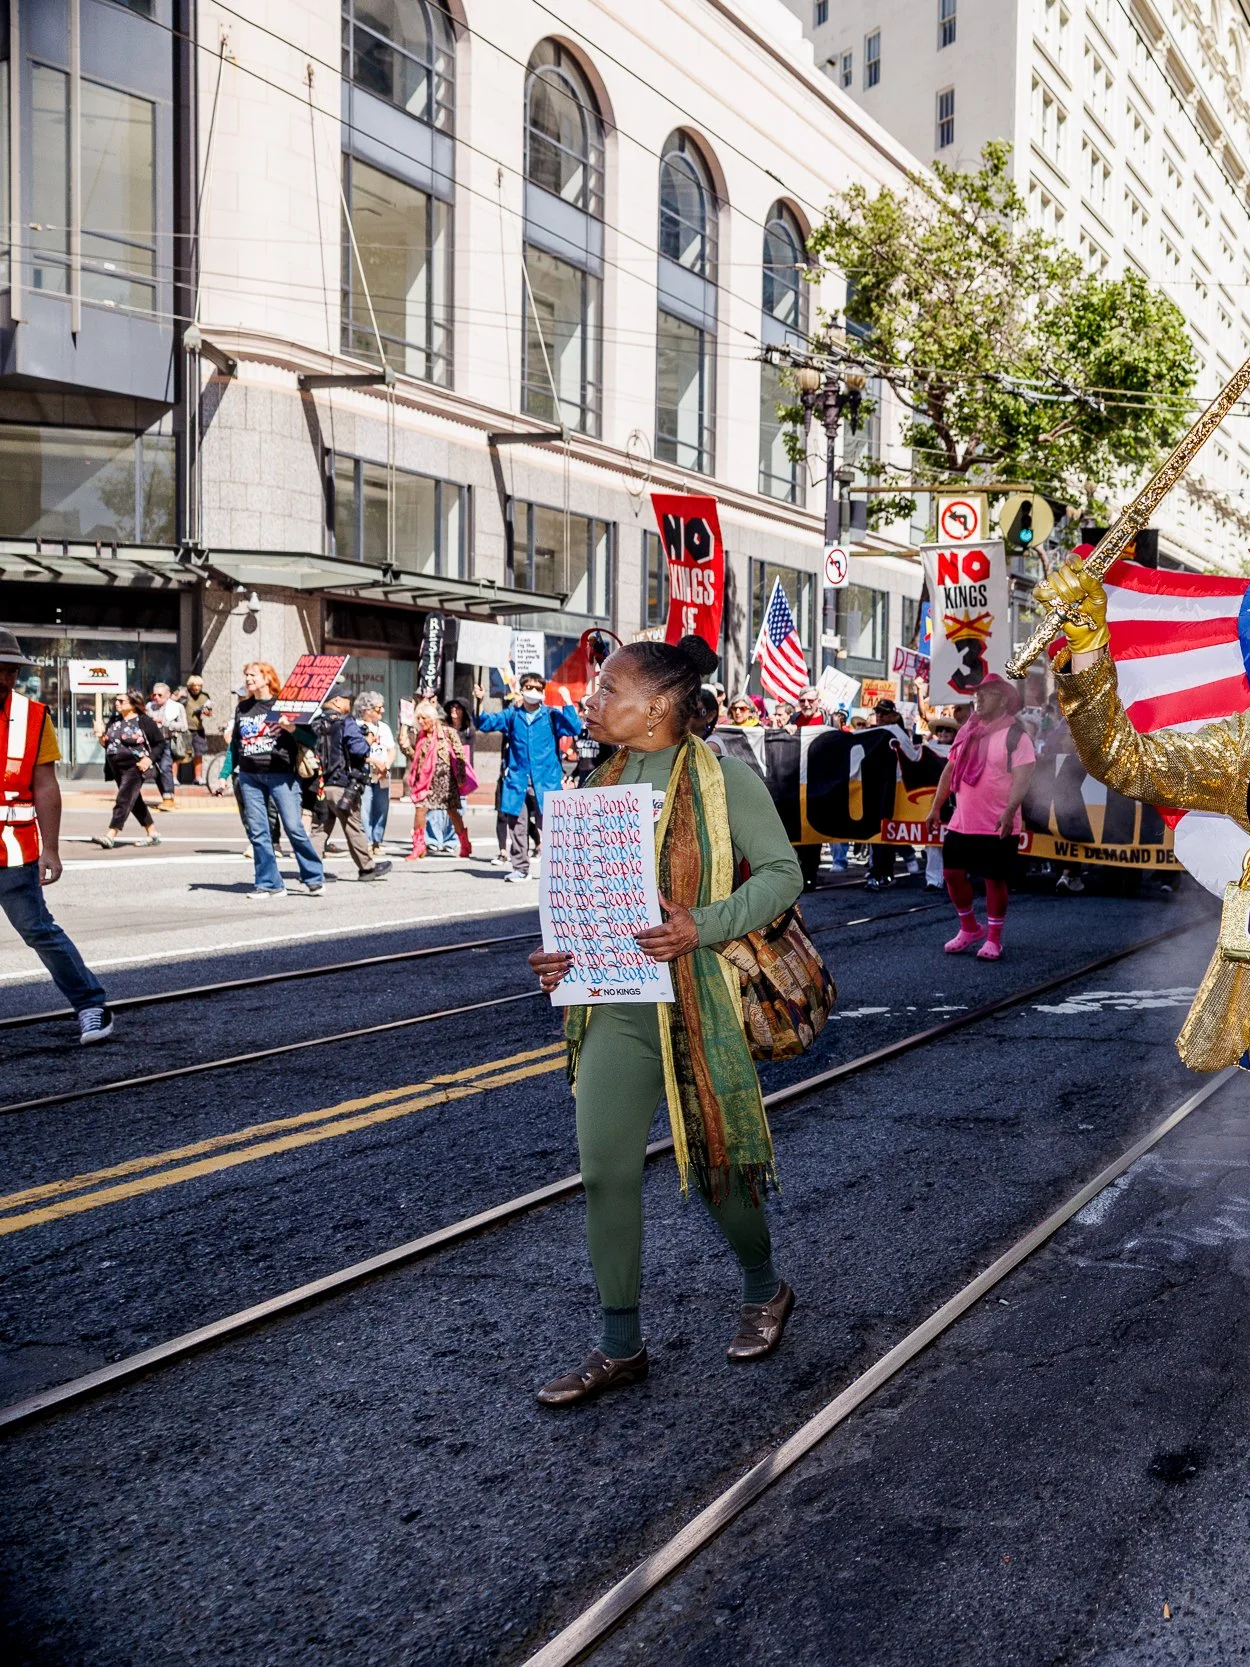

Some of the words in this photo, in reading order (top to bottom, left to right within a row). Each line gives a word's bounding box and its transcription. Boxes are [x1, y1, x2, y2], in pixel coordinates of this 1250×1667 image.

[662, 514, 715, 564] NO
[937, 549, 991, 586] NO
[670, 563, 715, 606] KINGS
[944, 584, 987, 609] KINGS
[297, 656, 315, 666] NO
[313, 655, 346, 667] KINGS
[425, 617, 440, 688] RESIST
[947, 638, 989, 695] 3
[286, 674, 311, 688] NO
[307, 675, 334, 689] ICE
[278, 687, 300, 700] NO
[297, 688, 328, 701] WAR
[552, 799, 571, 817] We
[592, 791, 640, 818] People
[551, 815, 571, 832] We
[592, 810, 640, 833] People
[886, 822, 921, 841] SAN
[551, 830, 571, 848] We
[592, 825, 641, 848] People
[550, 845, 571, 863] We
[592, 841, 641, 863] People
[1054, 841, 1079, 858] WE
[1084, 846, 1154, 864] DEMAND
[1155, 849, 1178, 864] DE
[550, 860, 571, 878] We
[592, 856, 642, 879] People
[549, 875, 573, 893] We
[593, 871, 644, 893] People
[549, 890, 572, 908] We
[595, 886, 646, 908] People
[549, 905, 575, 923] We
[597, 902, 648, 923] People
[551, 920, 578, 938] We
[554, 935, 582, 952] We
[602, 932, 639, 952] Peop
[608, 961, 660, 985] People
